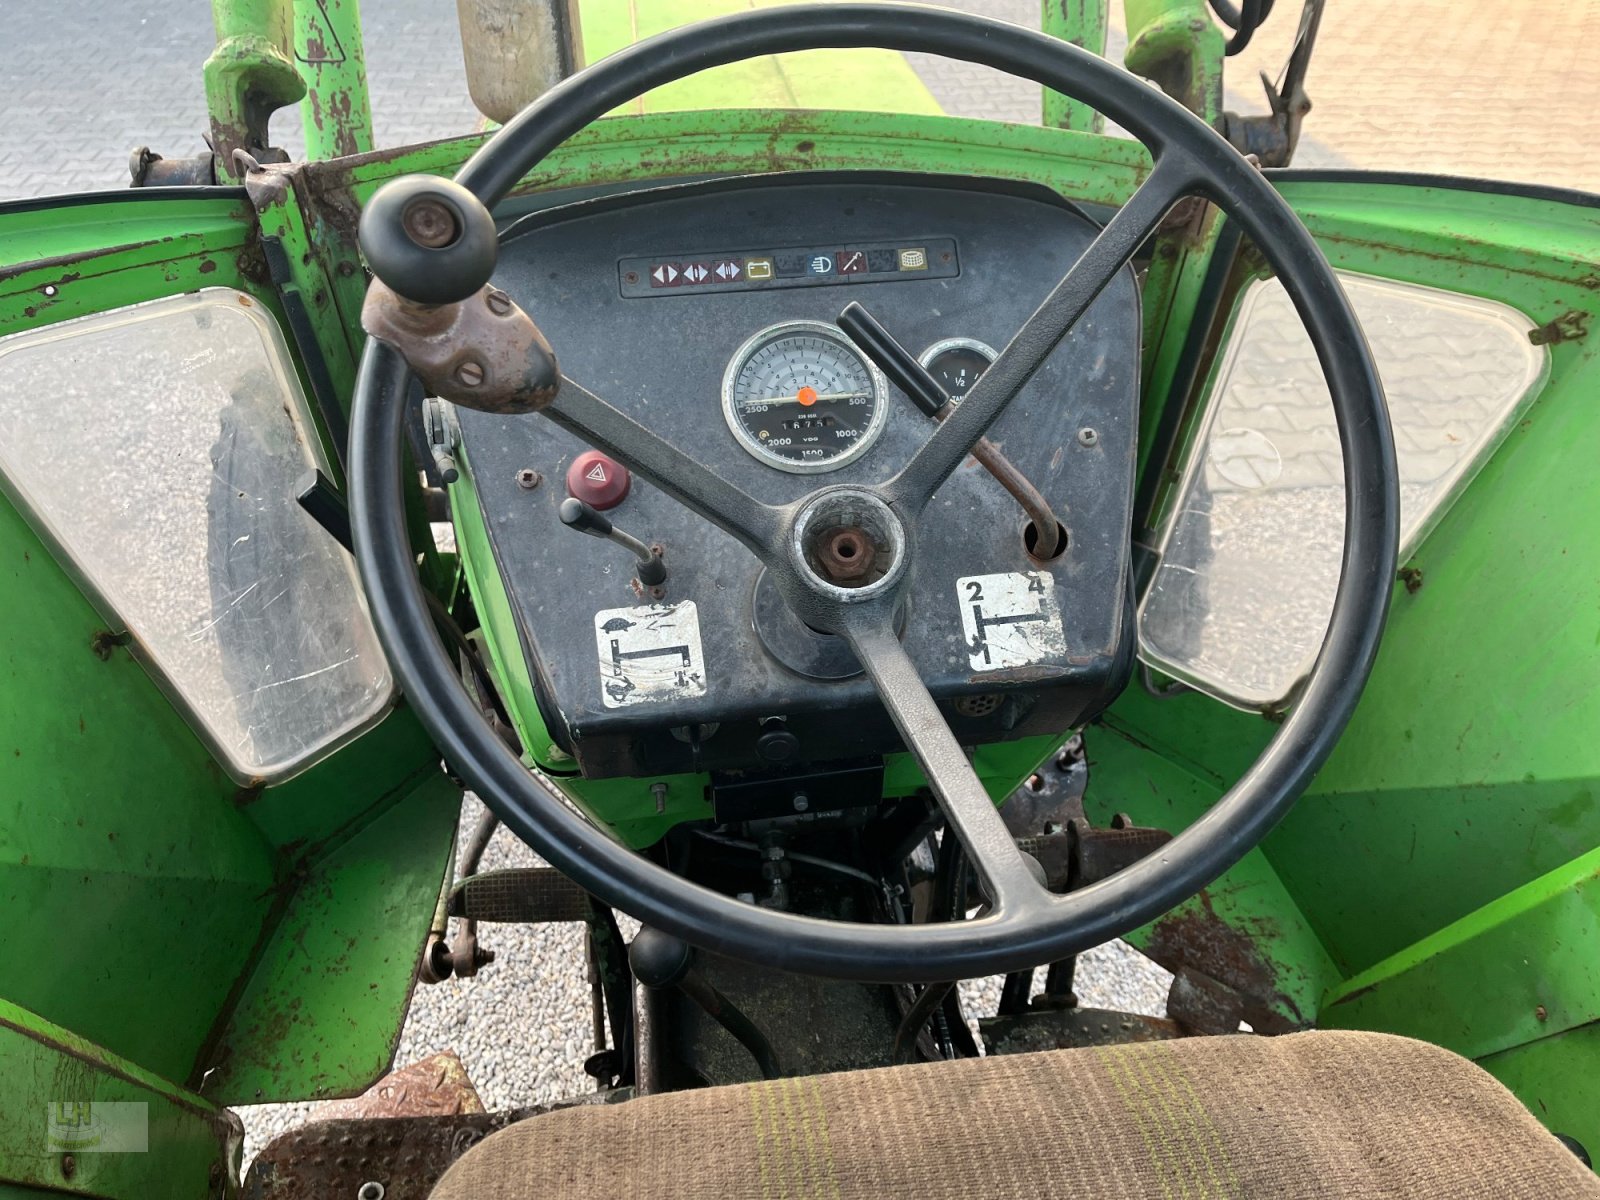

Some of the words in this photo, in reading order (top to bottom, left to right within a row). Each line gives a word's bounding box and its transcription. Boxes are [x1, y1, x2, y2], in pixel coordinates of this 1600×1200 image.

[848, 397, 866, 405] 500
[745, 405, 768, 413] 2500
[835, 430, 857, 438] 1000
[768, 438, 791, 446] 2000
[1027, 576, 1046, 595] 4
[966, 581, 984, 602] 2
